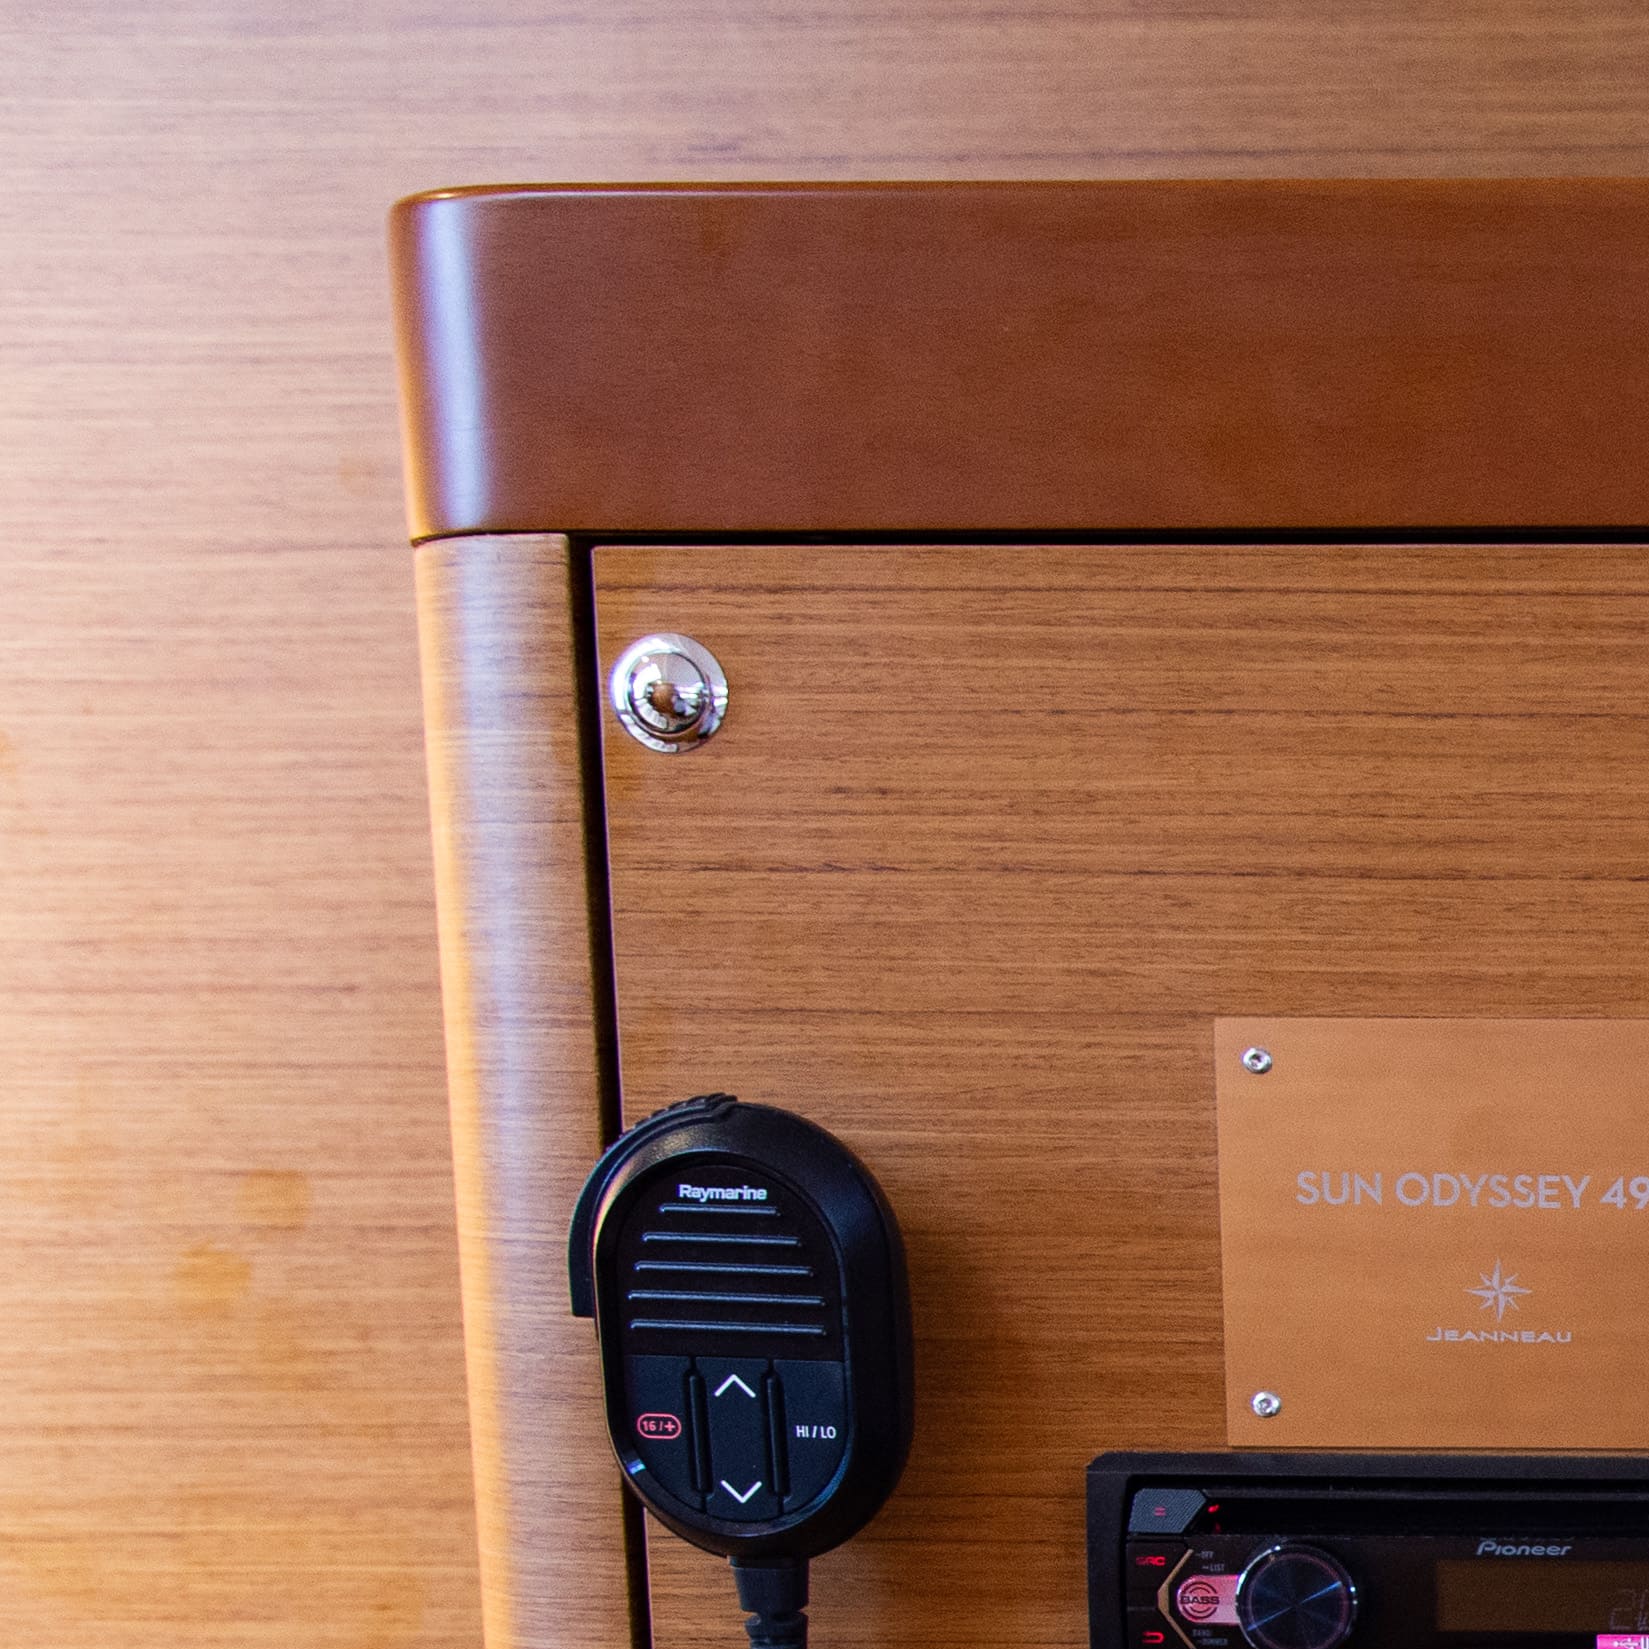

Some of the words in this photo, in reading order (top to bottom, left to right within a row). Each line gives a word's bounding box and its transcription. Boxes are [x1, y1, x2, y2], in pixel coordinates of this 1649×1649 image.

[679, 1184, 767, 1202] Raymarine
[1297, 1170, 1383, 1206] SUN
[1395, 1172, 1591, 1208] ODYSSEY
[1427, 1327, 1572, 1343] JEANNEAU
[1476, 1541, 1572, 1556] Pioneer
[1180, 1596, 1220, 1604] BASS
